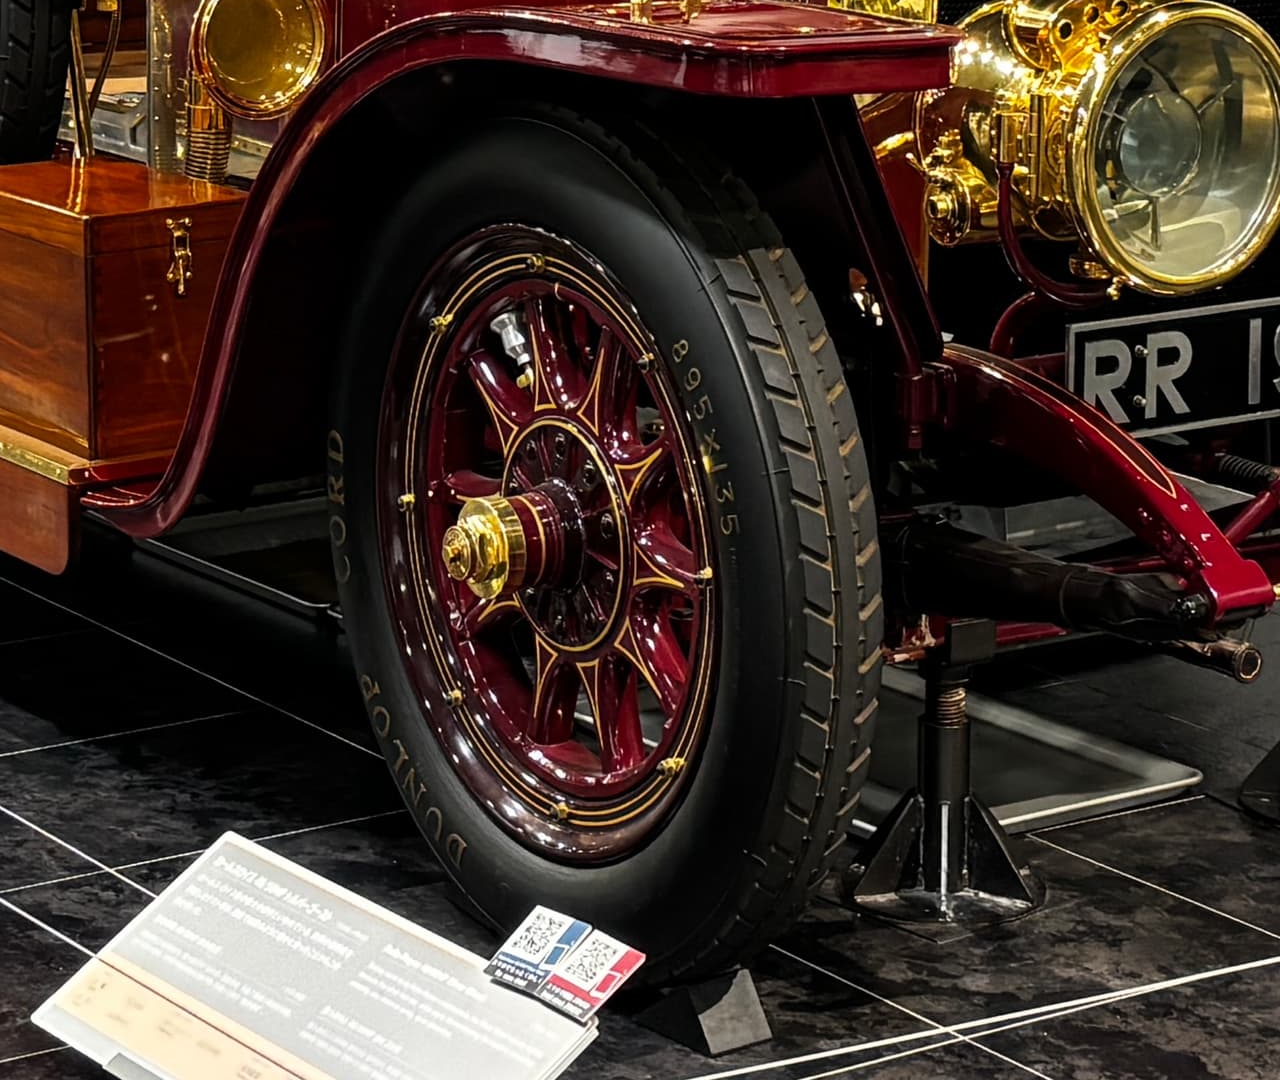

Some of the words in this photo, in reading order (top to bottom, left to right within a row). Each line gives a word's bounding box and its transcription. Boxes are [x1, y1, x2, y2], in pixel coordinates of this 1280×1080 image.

[1083, 330, 1193, 424] RR
[328, 429, 351, 584] CORD
[359, 673, 467, 871] DUNLOP
